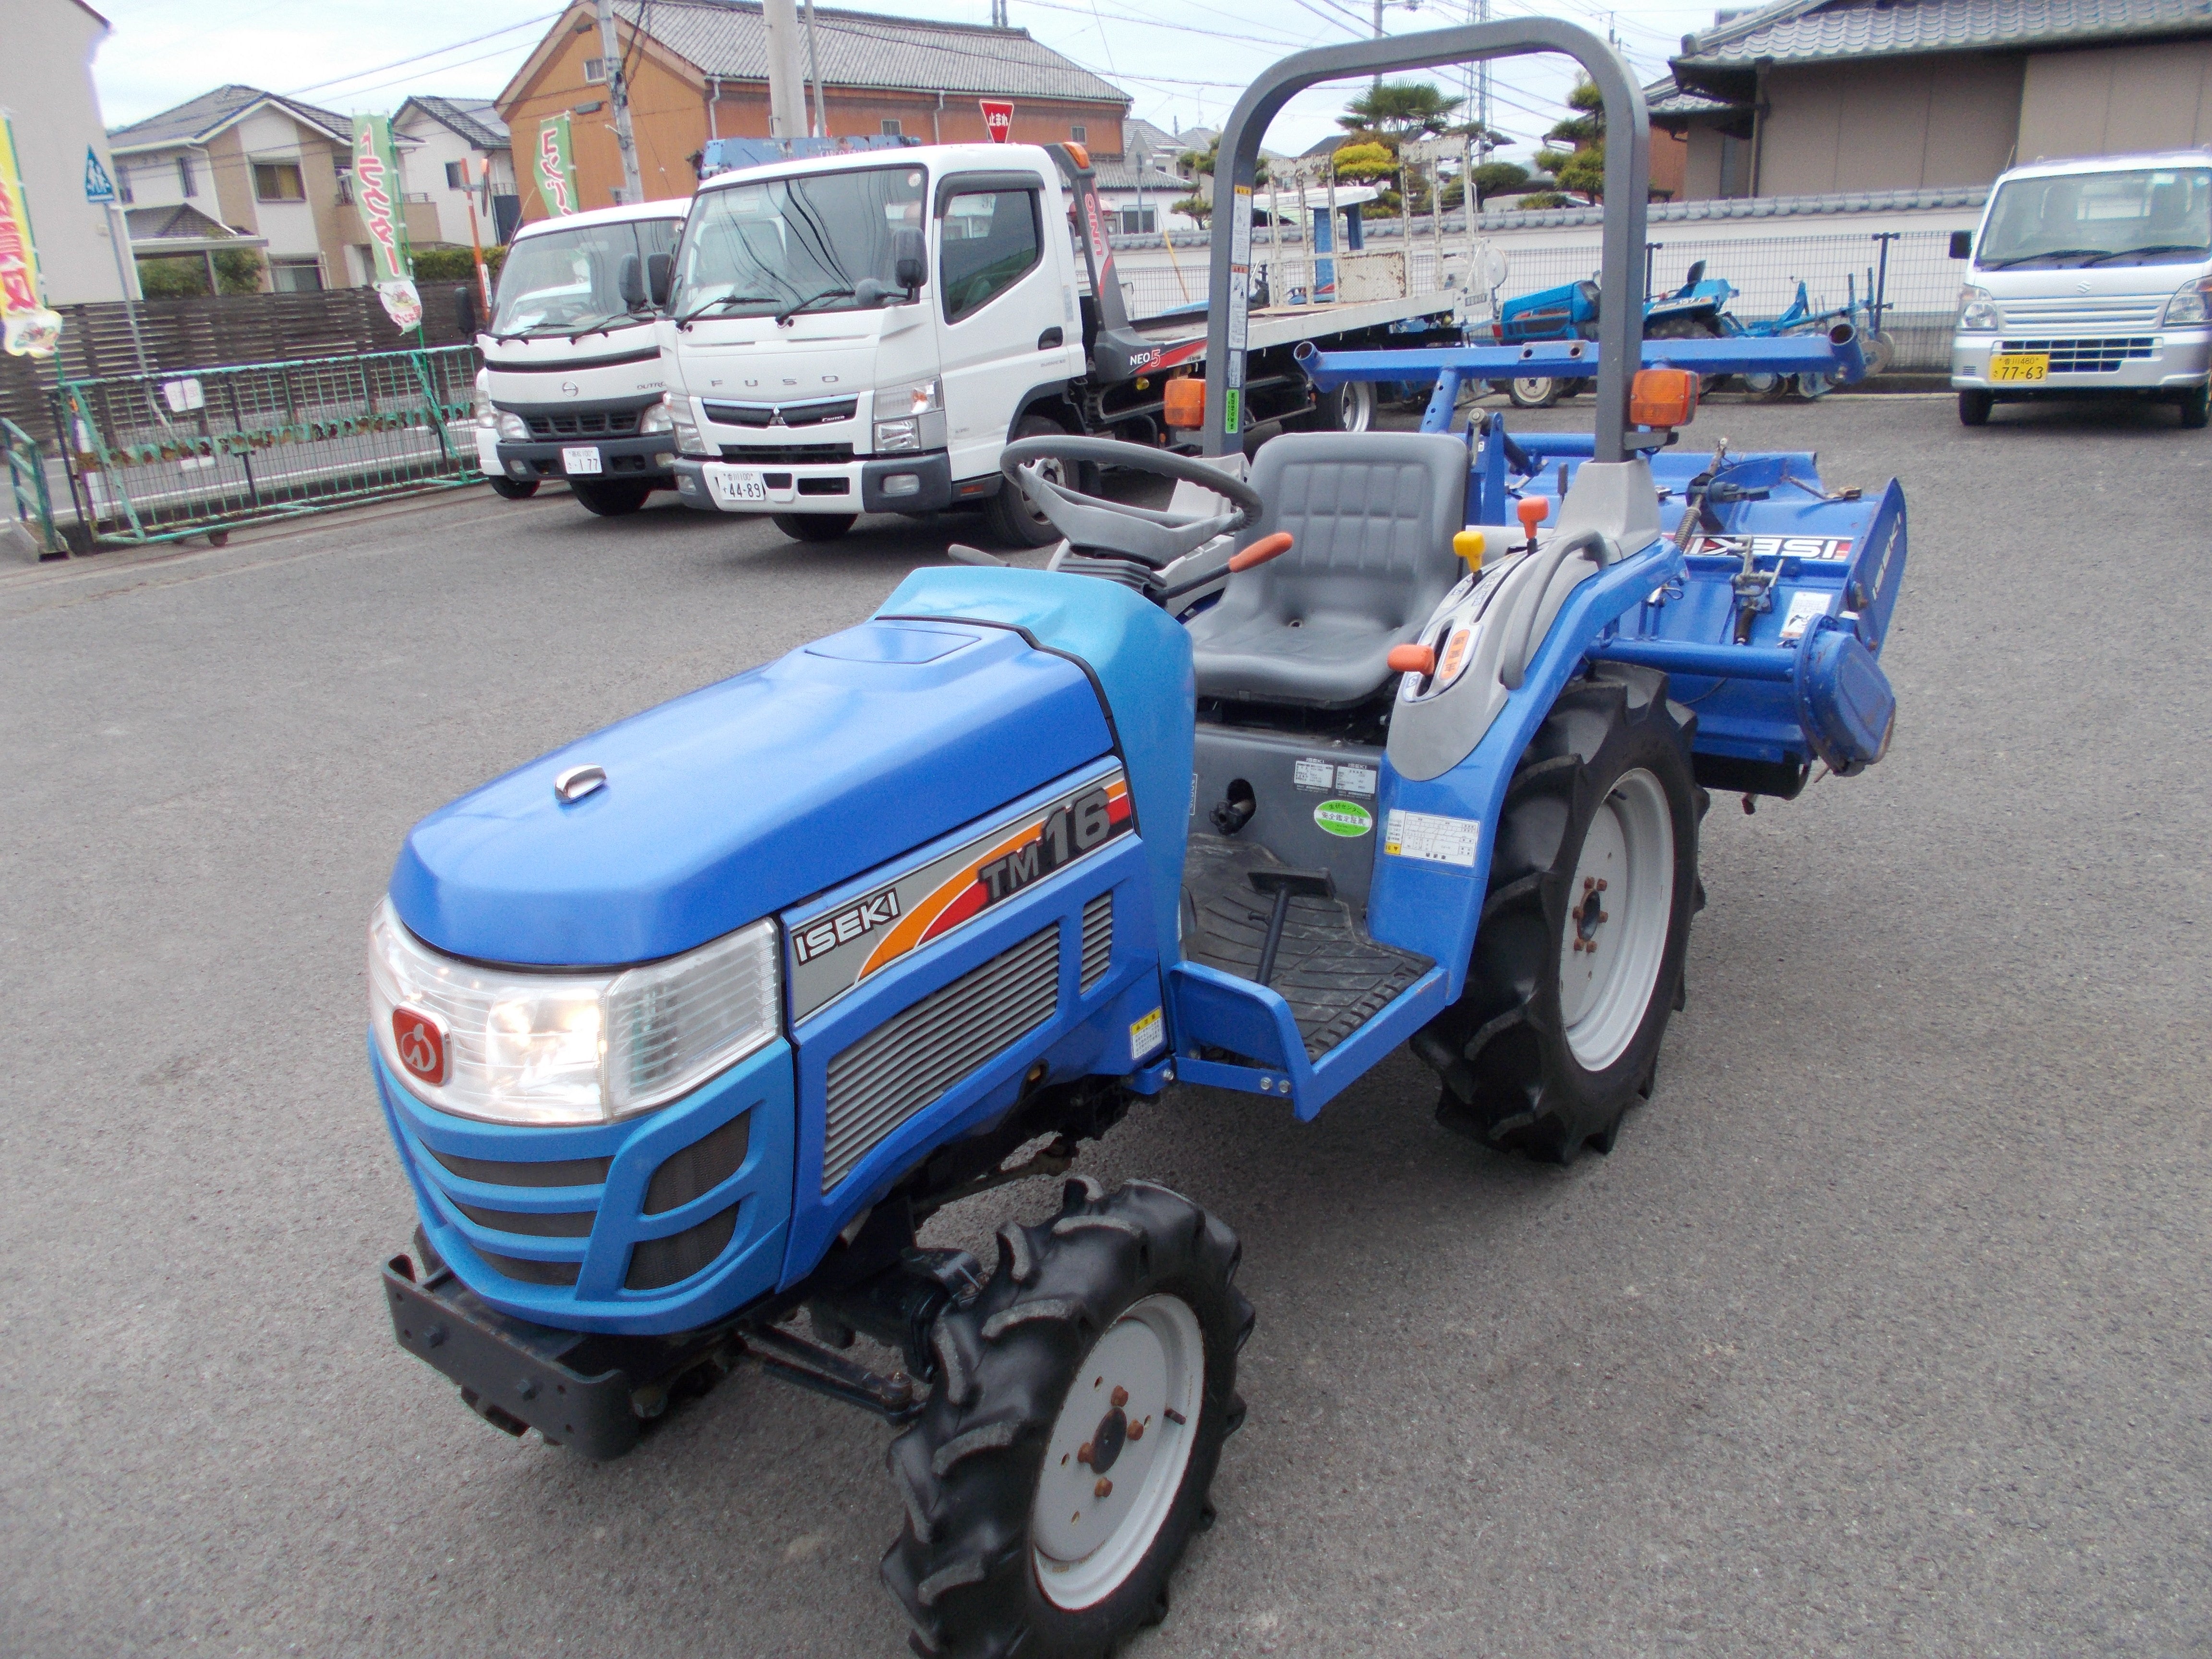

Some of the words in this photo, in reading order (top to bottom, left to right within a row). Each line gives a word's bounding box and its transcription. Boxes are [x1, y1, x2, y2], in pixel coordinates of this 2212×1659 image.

[989, 111, 1009, 126] 止まれ
[1085, 193, 1103, 256] UNIC
[2002, 366, 2044, 380] 77-63
[711, 375, 839, 387] FUSO
[730, 483, 761, 498] 44-89
[1329, 803, 1361, 815] 生研センター
[794, 889, 900, 964] ISEKI
